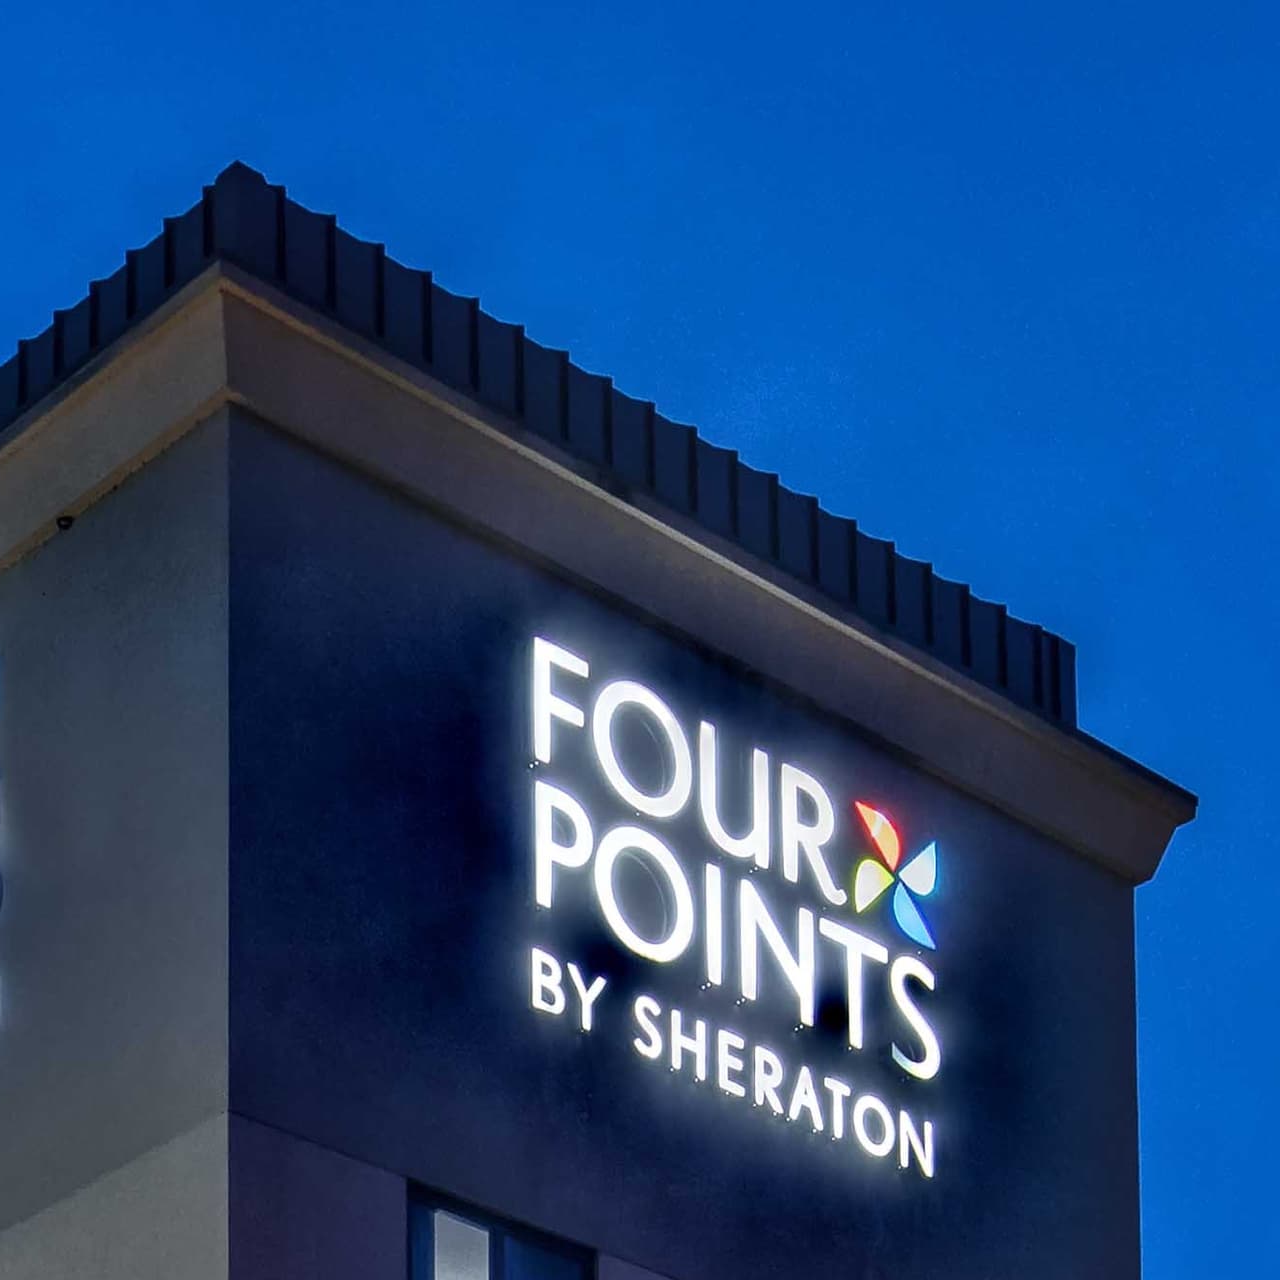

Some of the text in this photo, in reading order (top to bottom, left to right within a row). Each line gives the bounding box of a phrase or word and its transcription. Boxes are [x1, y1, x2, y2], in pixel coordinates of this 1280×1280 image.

[532, 636, 847, 906] FOUR
[530, 947, 935, 1178] BY SHERATON
[535, 779, 942, 1081] POINTS
